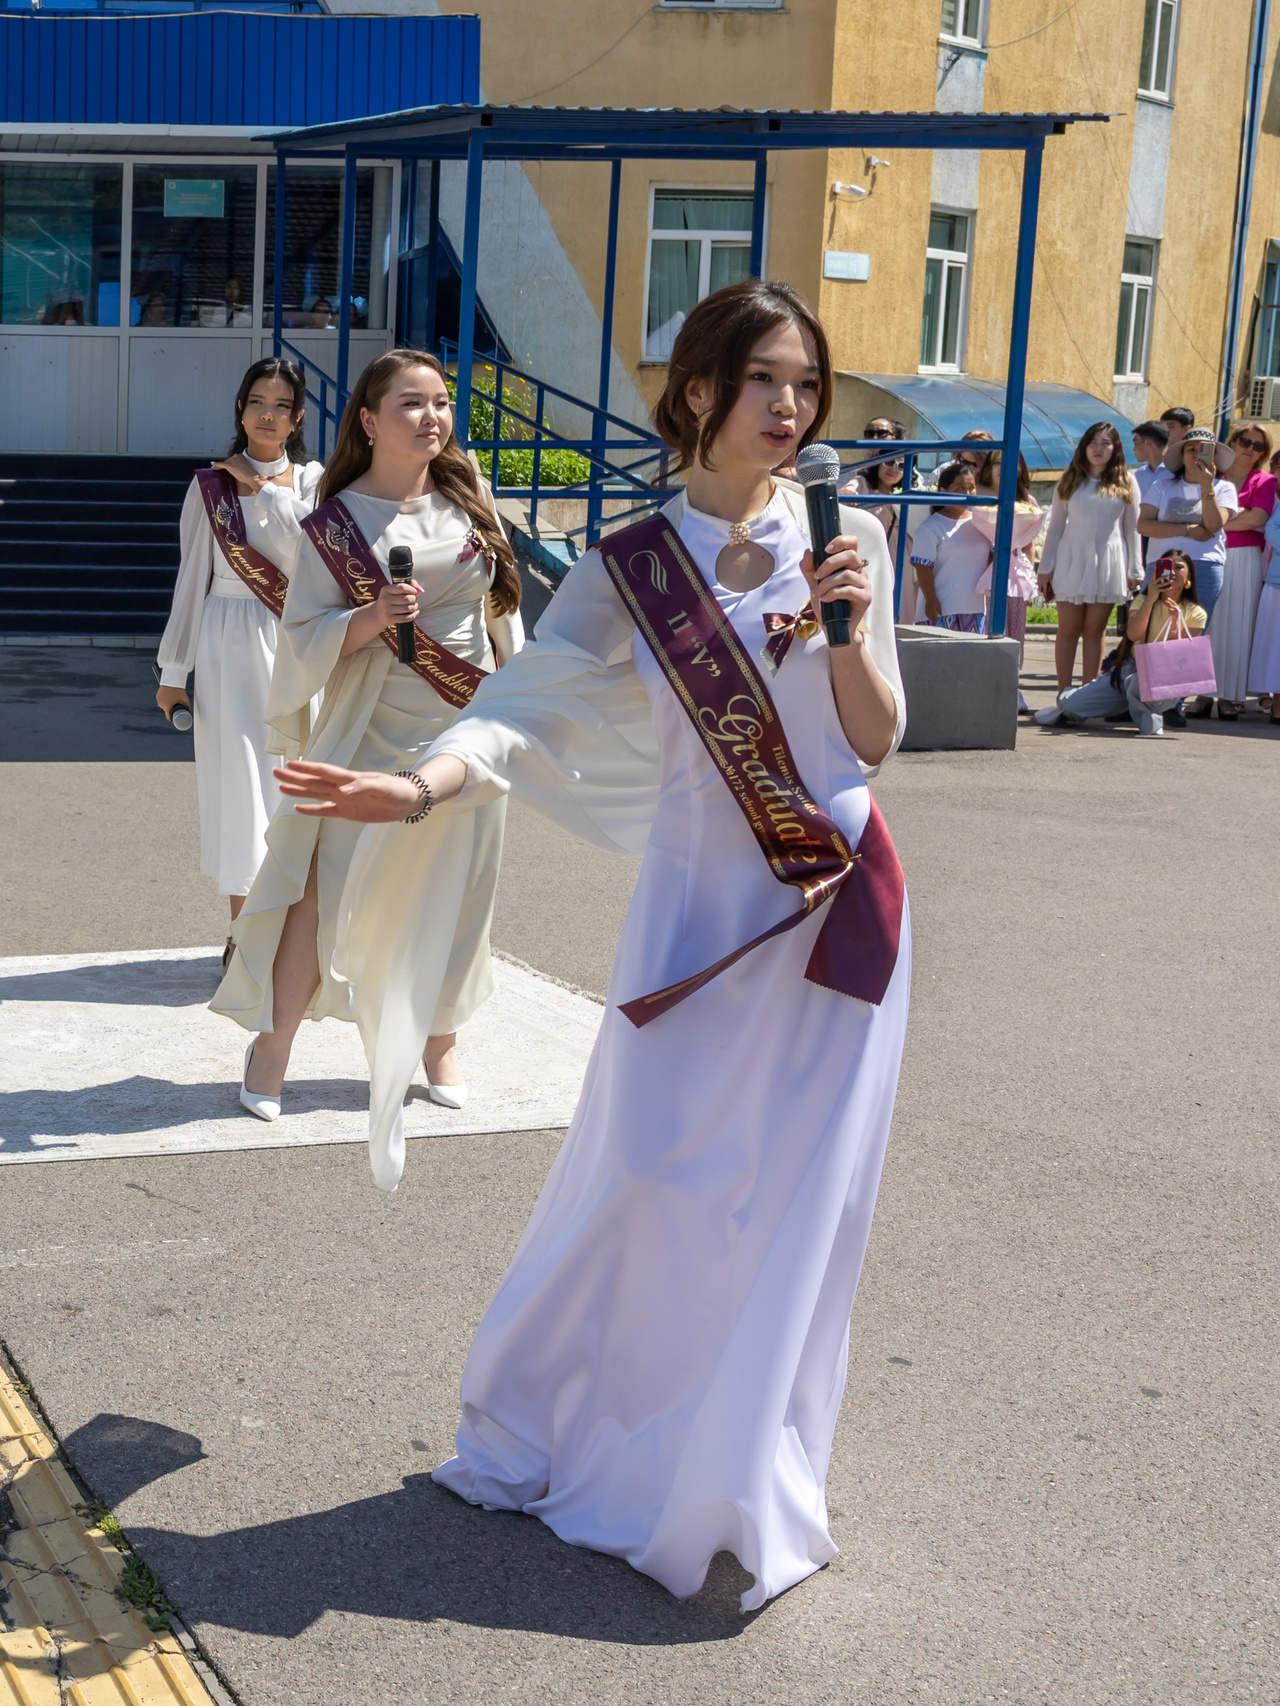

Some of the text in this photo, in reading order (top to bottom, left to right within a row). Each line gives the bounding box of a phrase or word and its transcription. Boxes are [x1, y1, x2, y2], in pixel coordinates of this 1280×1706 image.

[413, 624, 435, 647] raduate
[697, 694, 824, 865] Graduate
[725, 765, 745, 791] №172
[738, 791, 761, 820] school
[772, 743, 818, 816] Tilemis Saida
